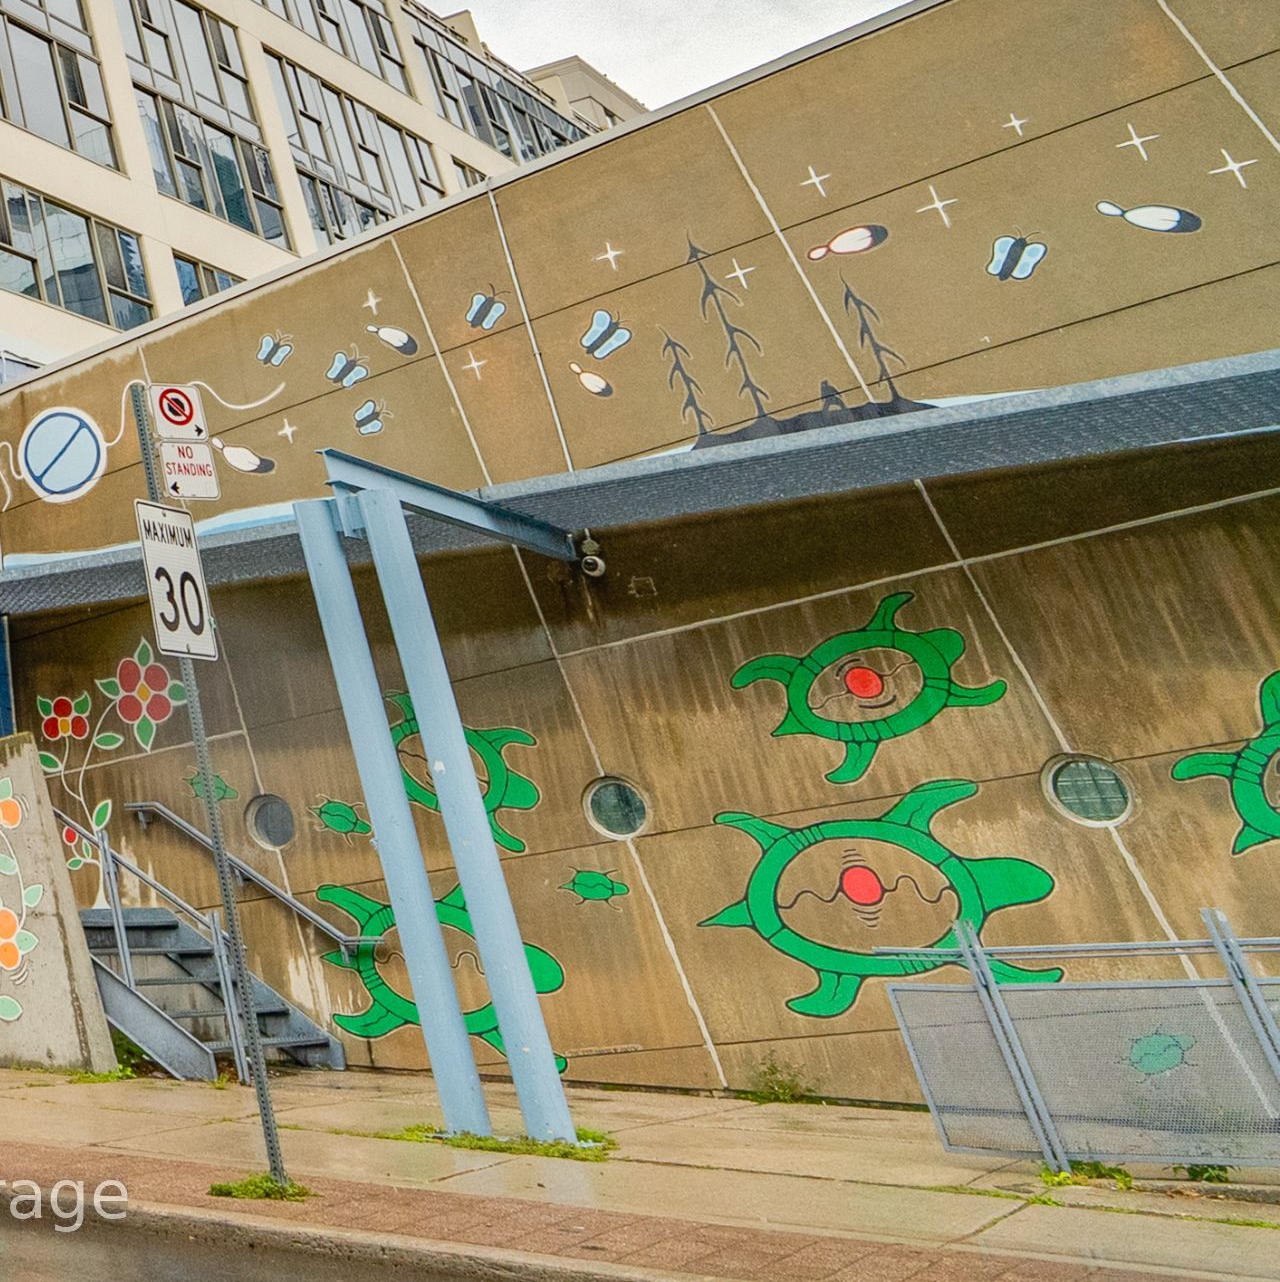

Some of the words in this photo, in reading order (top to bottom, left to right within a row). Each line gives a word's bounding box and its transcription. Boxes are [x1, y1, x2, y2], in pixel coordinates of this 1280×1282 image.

[177, 445, 194, 460] NO
[165, 461, 213, 478] STANDING
[142, 518, 194, 550] MAXIMUM
[154, 566, 205, 637] 30
